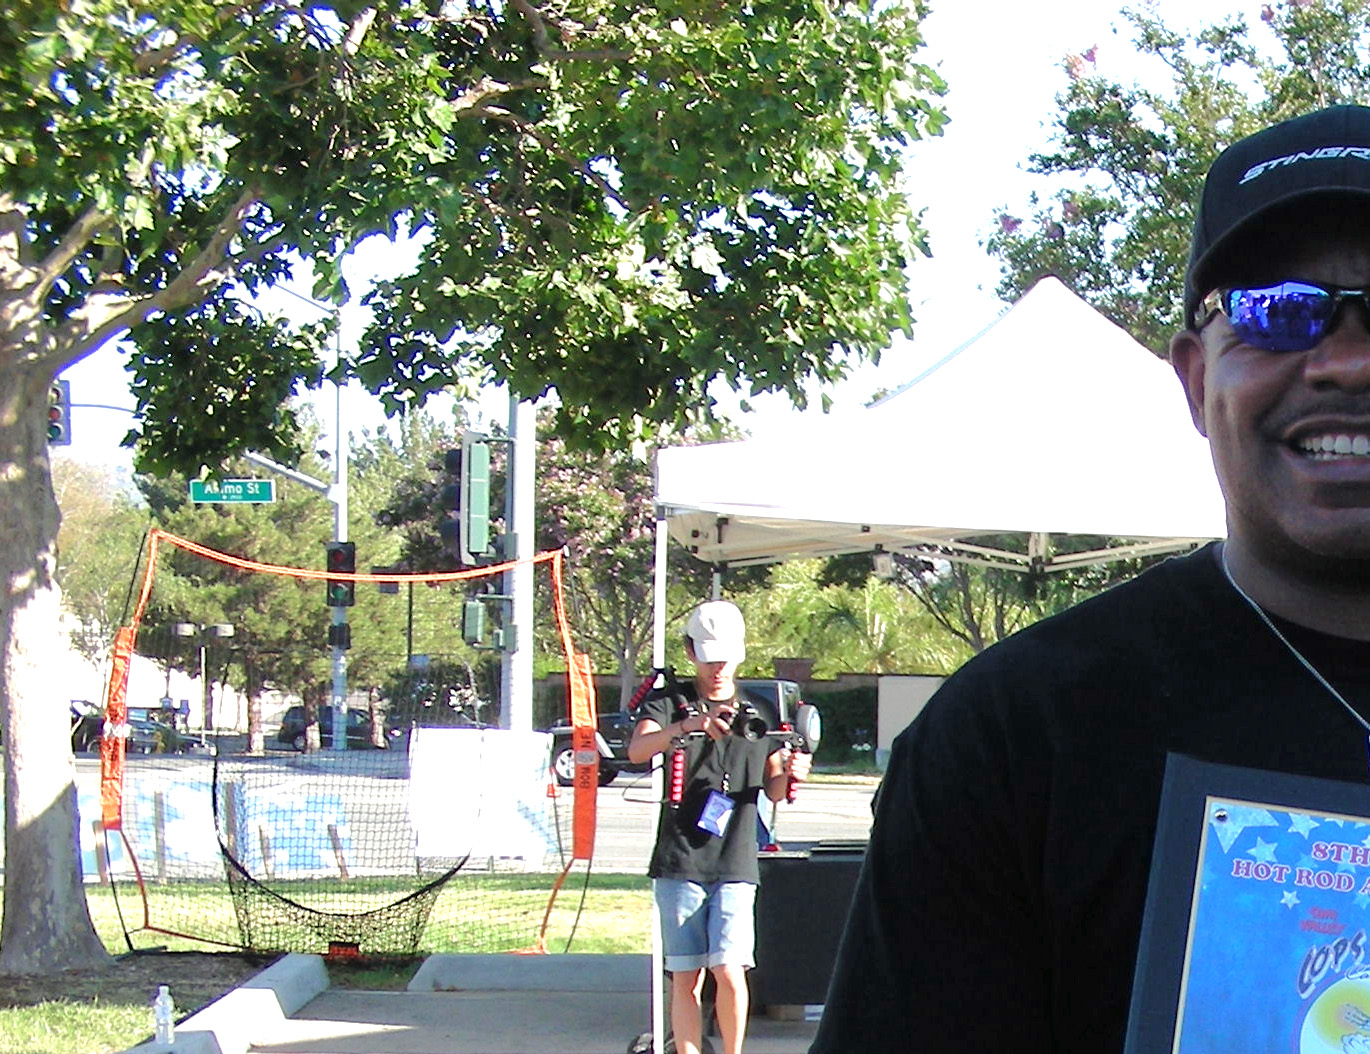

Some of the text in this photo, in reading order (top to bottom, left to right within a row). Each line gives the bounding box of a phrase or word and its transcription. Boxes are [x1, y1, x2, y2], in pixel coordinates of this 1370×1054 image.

[247, 482, 260, 494] St
[1312, 841, 1370, 867] 8TH
[1231, 859, 1291, 884] HOT
[1295, 868, 1354, 892] ROD
[1297, 929, 1367, 1000] COPS
